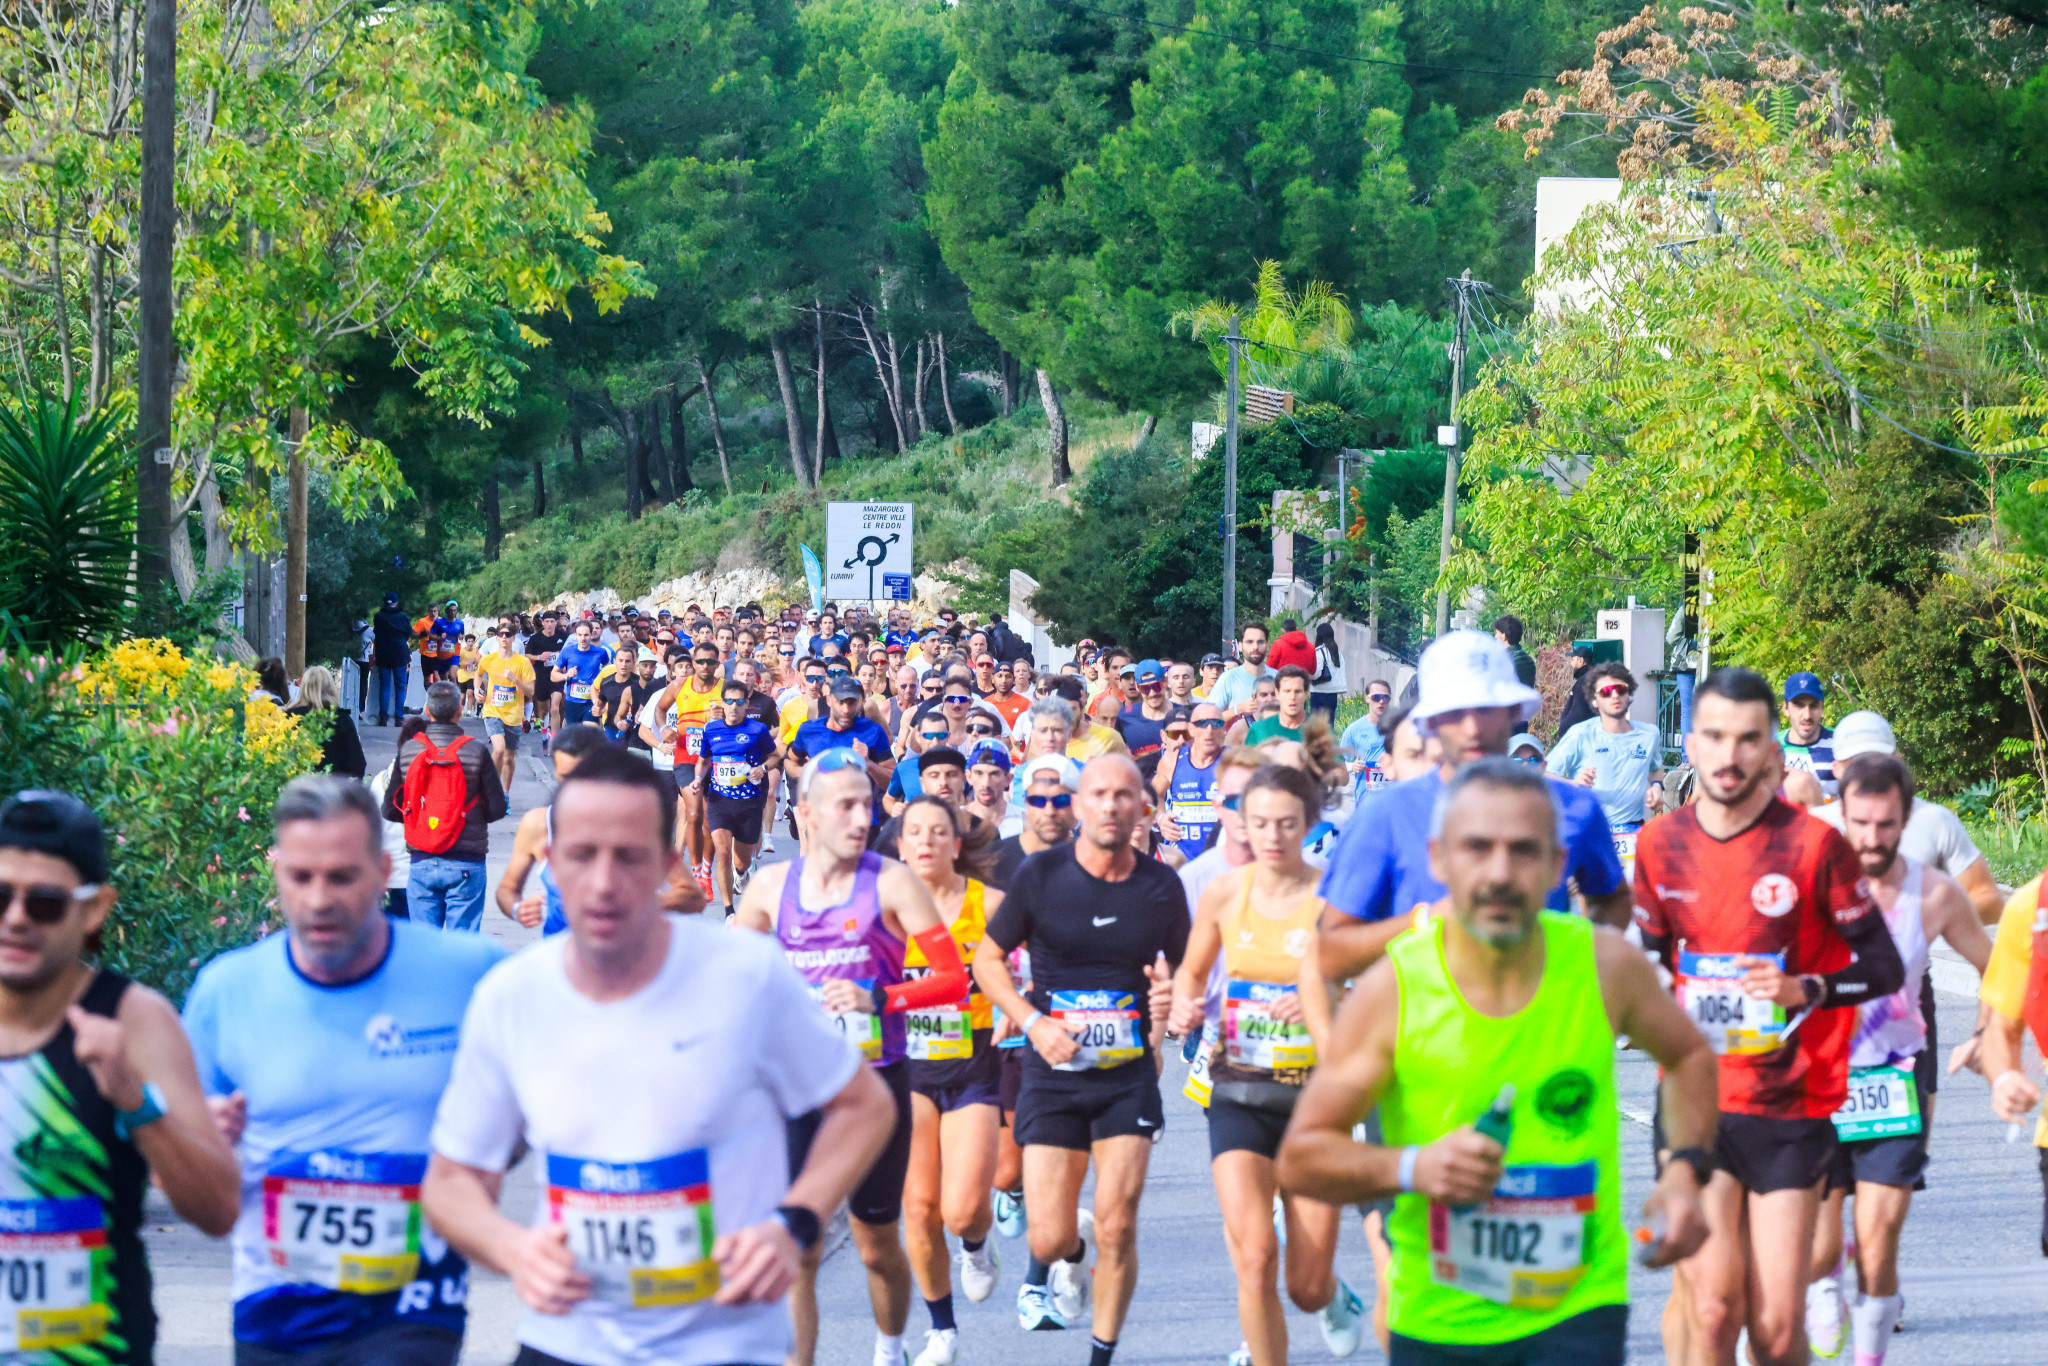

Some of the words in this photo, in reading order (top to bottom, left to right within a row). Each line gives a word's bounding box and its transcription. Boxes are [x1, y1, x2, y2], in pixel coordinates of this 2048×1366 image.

[1605, 620, 1618, 630] 125
[692, 738, 702, 748] 20
[720, 767, 736, 776] 976
[1616, 840, 1628, 854] 23
[1696, 995, 1744, 1024] 1064
[1074, 1024, 1116, 1047] 209
[1246, 1014, 1290, 1041] 2024
[1839, 1084, 1889, 1113] 5150
[296, 1203, 374, 1247] 755
[584, 1218, 656, 1262] 1146
[1472, 1219, 1542, 1265] 1102
[0, 1258, 45, 1303] 01
[396, 1277, 467, 1316] RU
